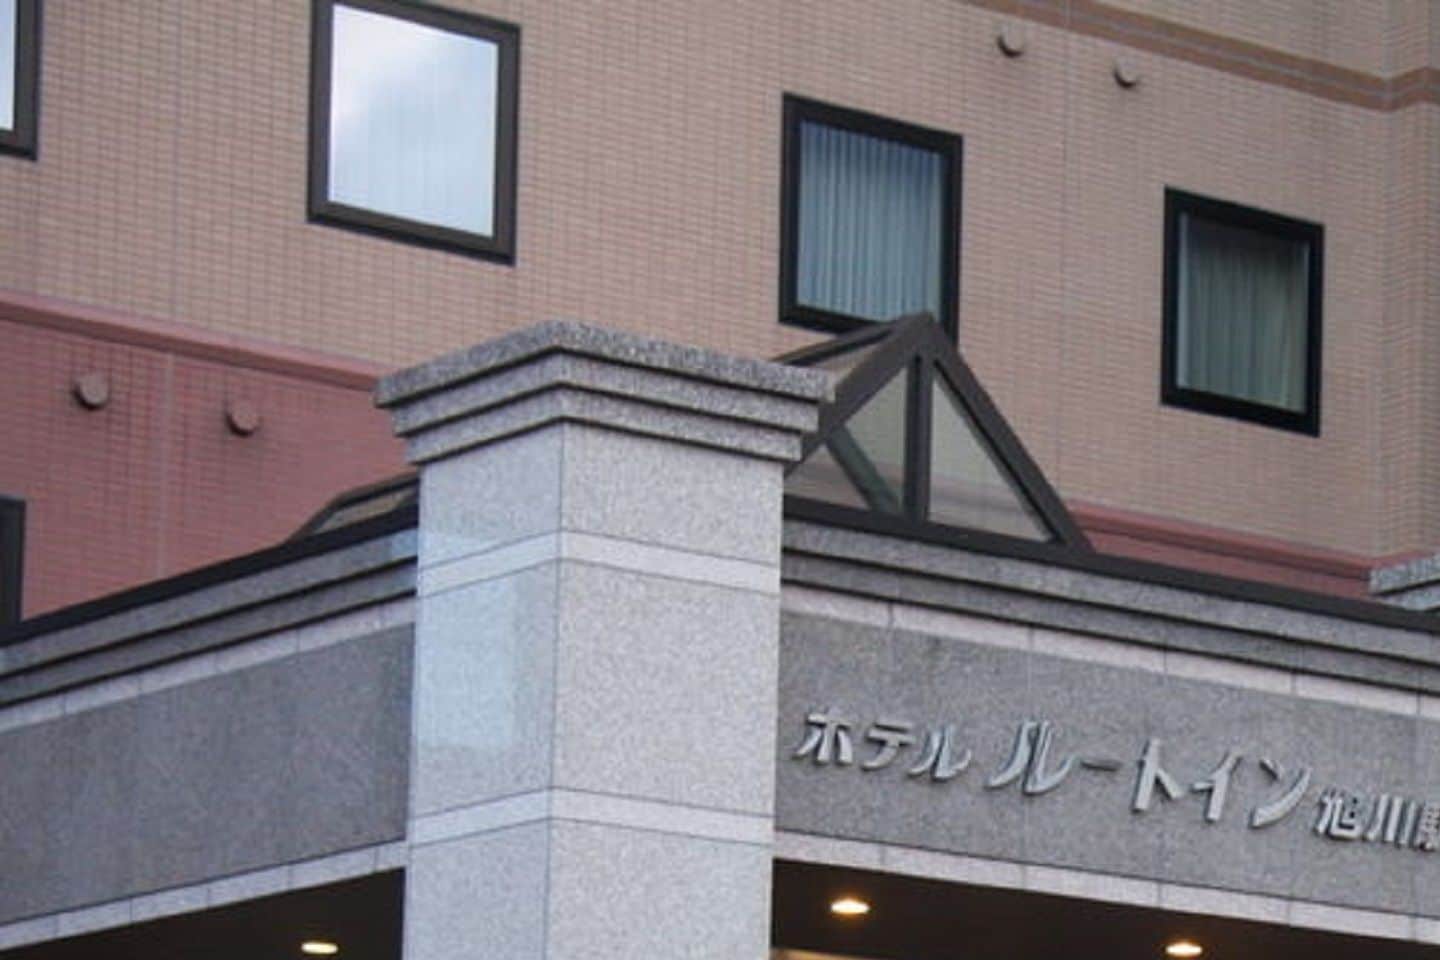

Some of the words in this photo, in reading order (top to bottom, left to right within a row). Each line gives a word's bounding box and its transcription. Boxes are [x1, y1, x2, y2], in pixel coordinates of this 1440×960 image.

[793, 711, 972, 781] ホテル
[987, 718, 1311, 829] ルートイン
